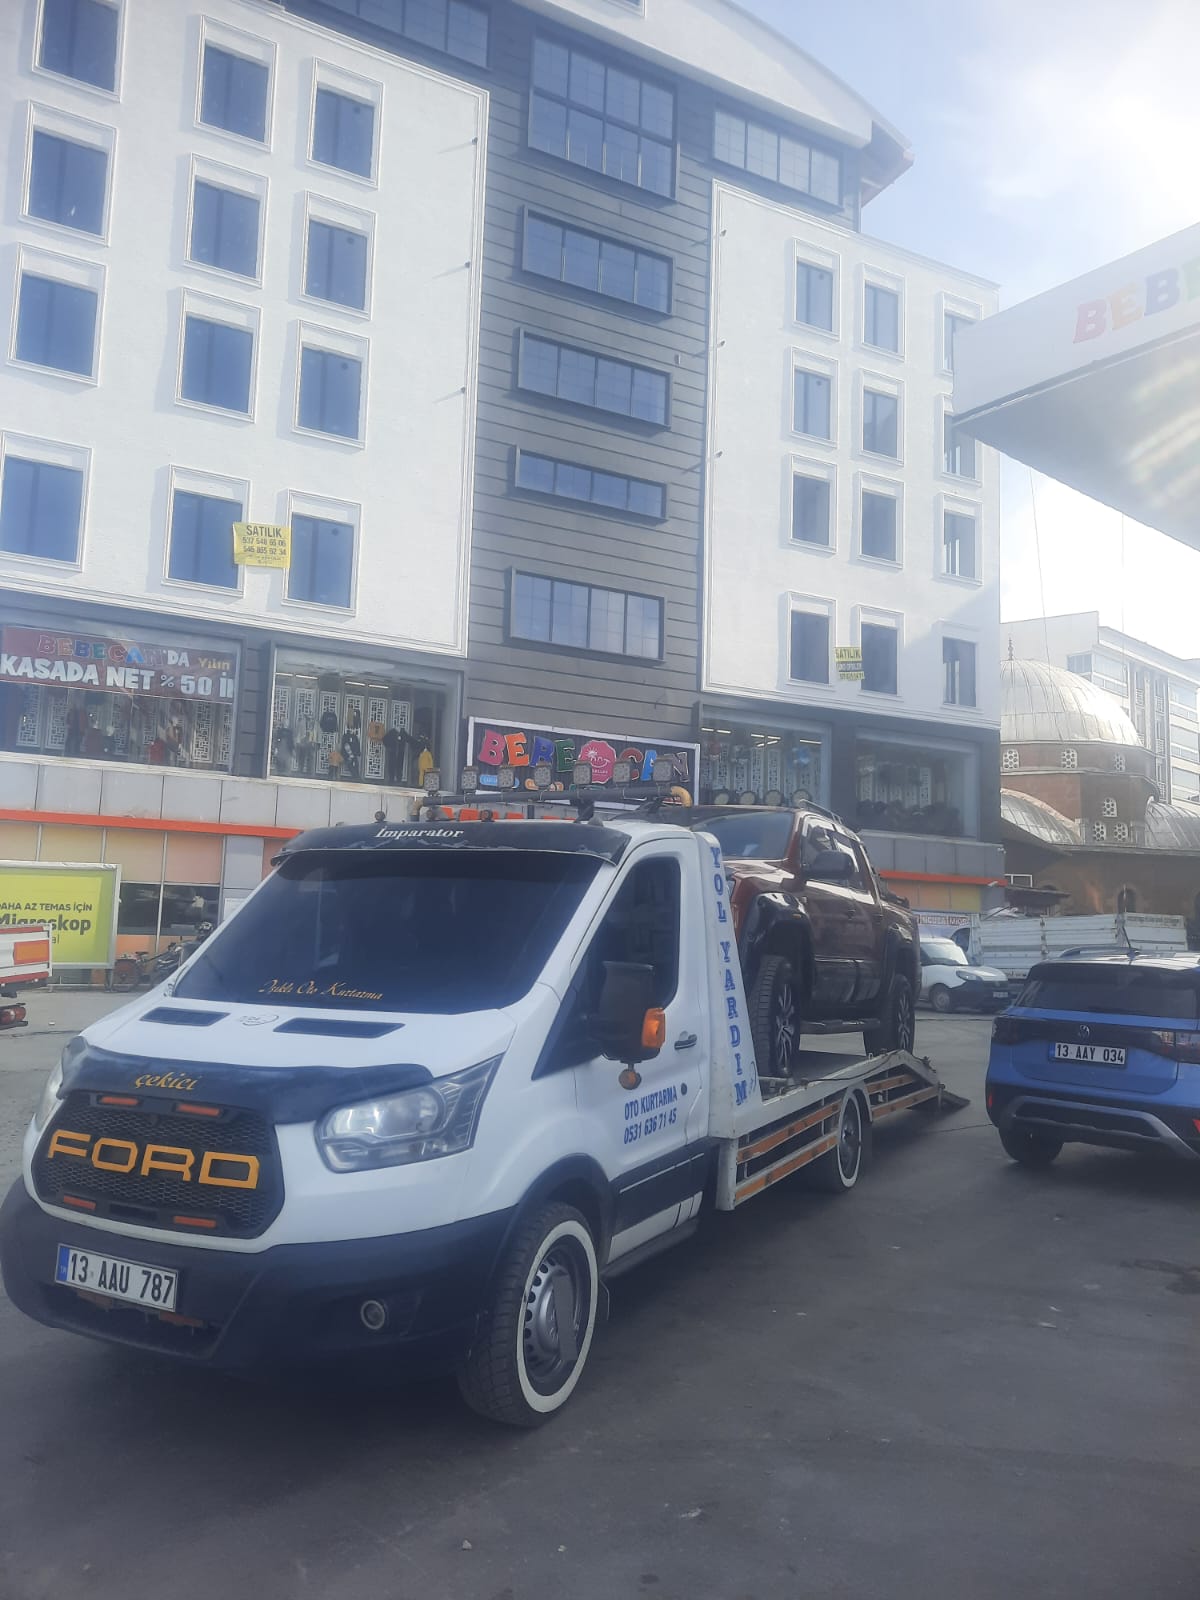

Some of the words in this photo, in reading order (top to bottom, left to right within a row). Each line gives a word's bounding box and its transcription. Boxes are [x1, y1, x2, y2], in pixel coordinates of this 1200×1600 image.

[246, 525, 282, 538] SATILIK
[0, 653, 100, 686] KASADA
[106, 666, 156, 690] NET
[160, 674, 175, 688] %
[180, 674, 213, 696] 50
[24, 902, 37, 911] AZ
[40, 903, 71, 911] TEMAS
[73, 902, 93, 913] İÇİN
[710, 846, 727, 923] YOL
[720, 941, 748, 1106] YARDIM
[1056, 1044, 1069, 1057] 13
[1075, 1045, 1096, 1060] AAY
[1103, 1048, 1124, 1063] 034
[135, 1071, 203, 1090] çekici
[624, 1100, 639, 1121] OTO
[640, 1085, 678, 1115] KURTARMA
[623, 1121, 642, 1145] 0531
[644, 1115, 658, 1136] 636
[658, 1112, 667, 1130] 71
[668, 1107, 677, 1125] 45
[48, 1129, 260, 1189] FORD
[71, 1253, 89, 1283] 13
[98, 1260, 131, 1294] AAU
[140, 1269, 174, 1304] 787
